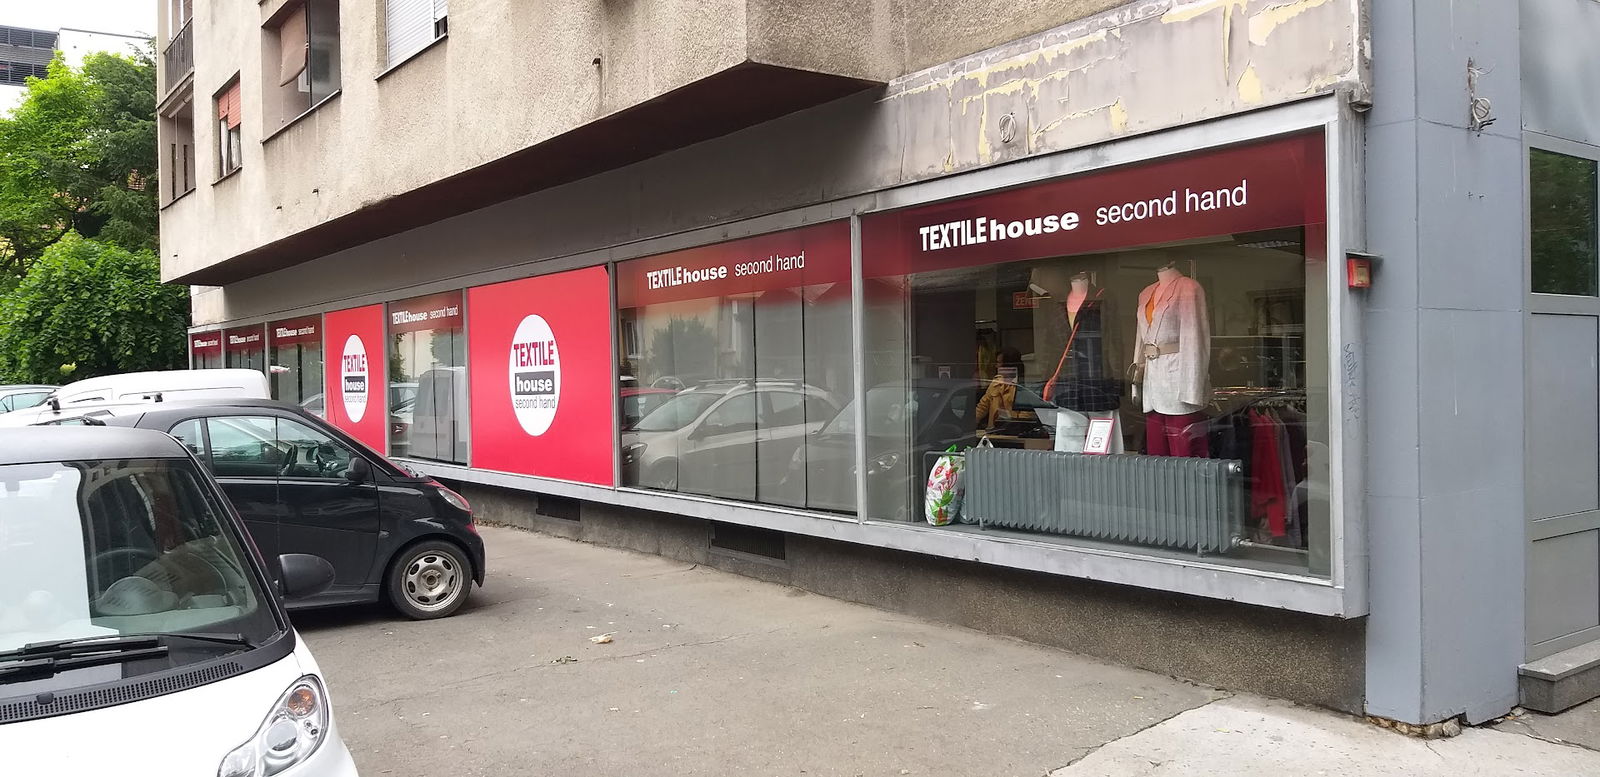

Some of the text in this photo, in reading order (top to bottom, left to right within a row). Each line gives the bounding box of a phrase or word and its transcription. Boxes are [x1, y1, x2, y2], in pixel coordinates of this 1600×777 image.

[1095, 190, 1177, 226] second
[1185, 179, 1248, 213] hand
[734, 255, 773, 277] second
[776, 250, 805, 272] hand
[429, 306, 446, 320] second
[446, 304, 459, 317] hand
[513, 340, 555, 368] TEXTILE
[343, 354, 366, 373] TEXTILE
[345, 378, 365, 391] house
[516, 375, 553, 393] house
[515, 395, 556, 409] second hand
